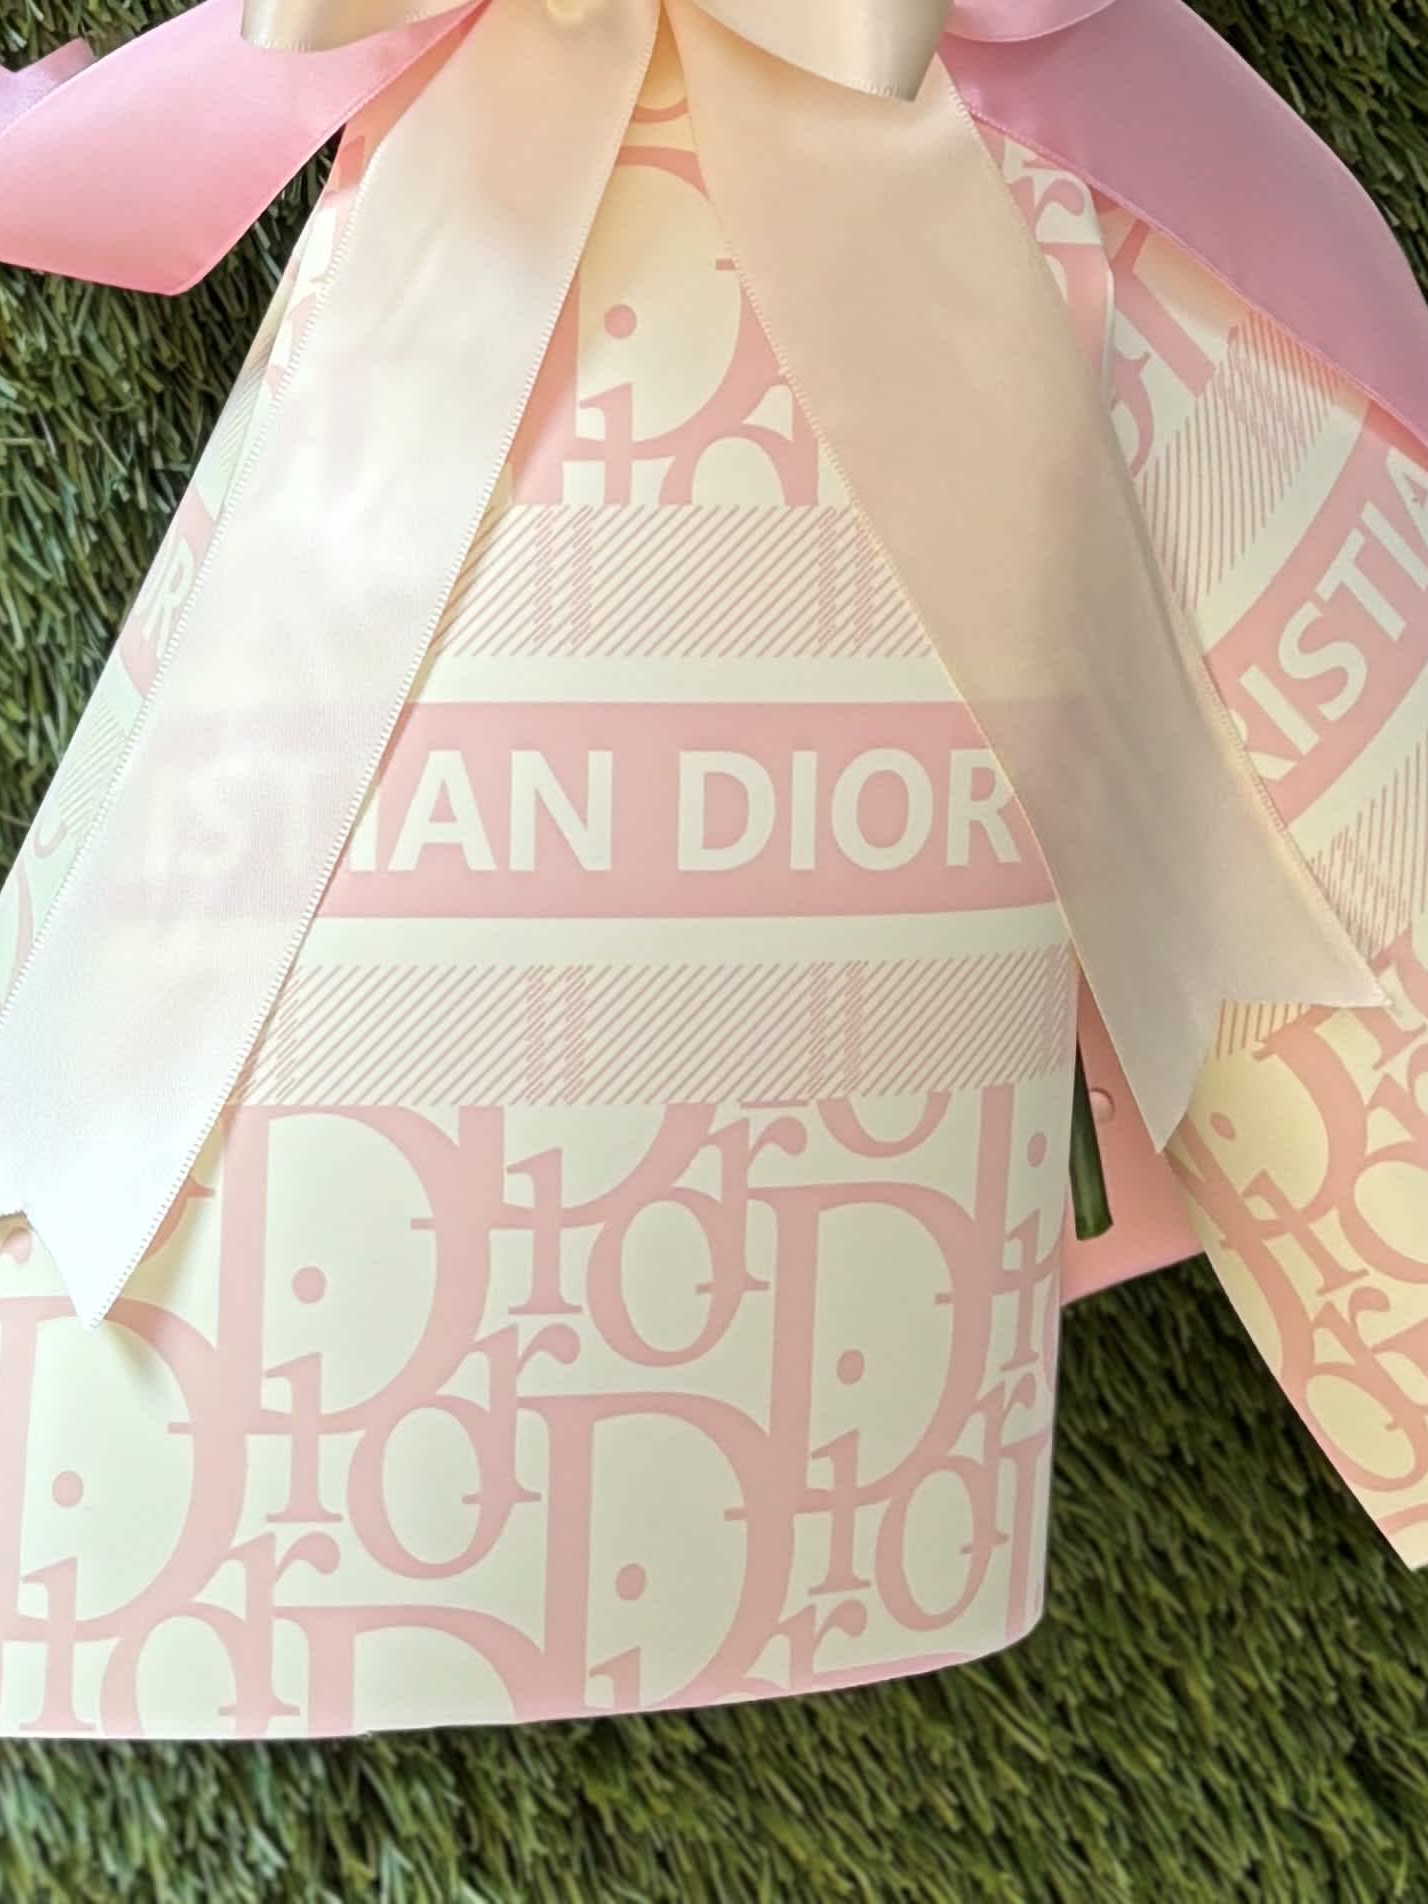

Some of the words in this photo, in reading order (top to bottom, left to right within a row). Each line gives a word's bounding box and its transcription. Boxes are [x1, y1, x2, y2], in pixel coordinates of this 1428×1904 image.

[676, 747, 1021, 873] DIOR
[168, 1105, 581, 1579] Dior
[724, 1182, 1036, 1632] Dior
